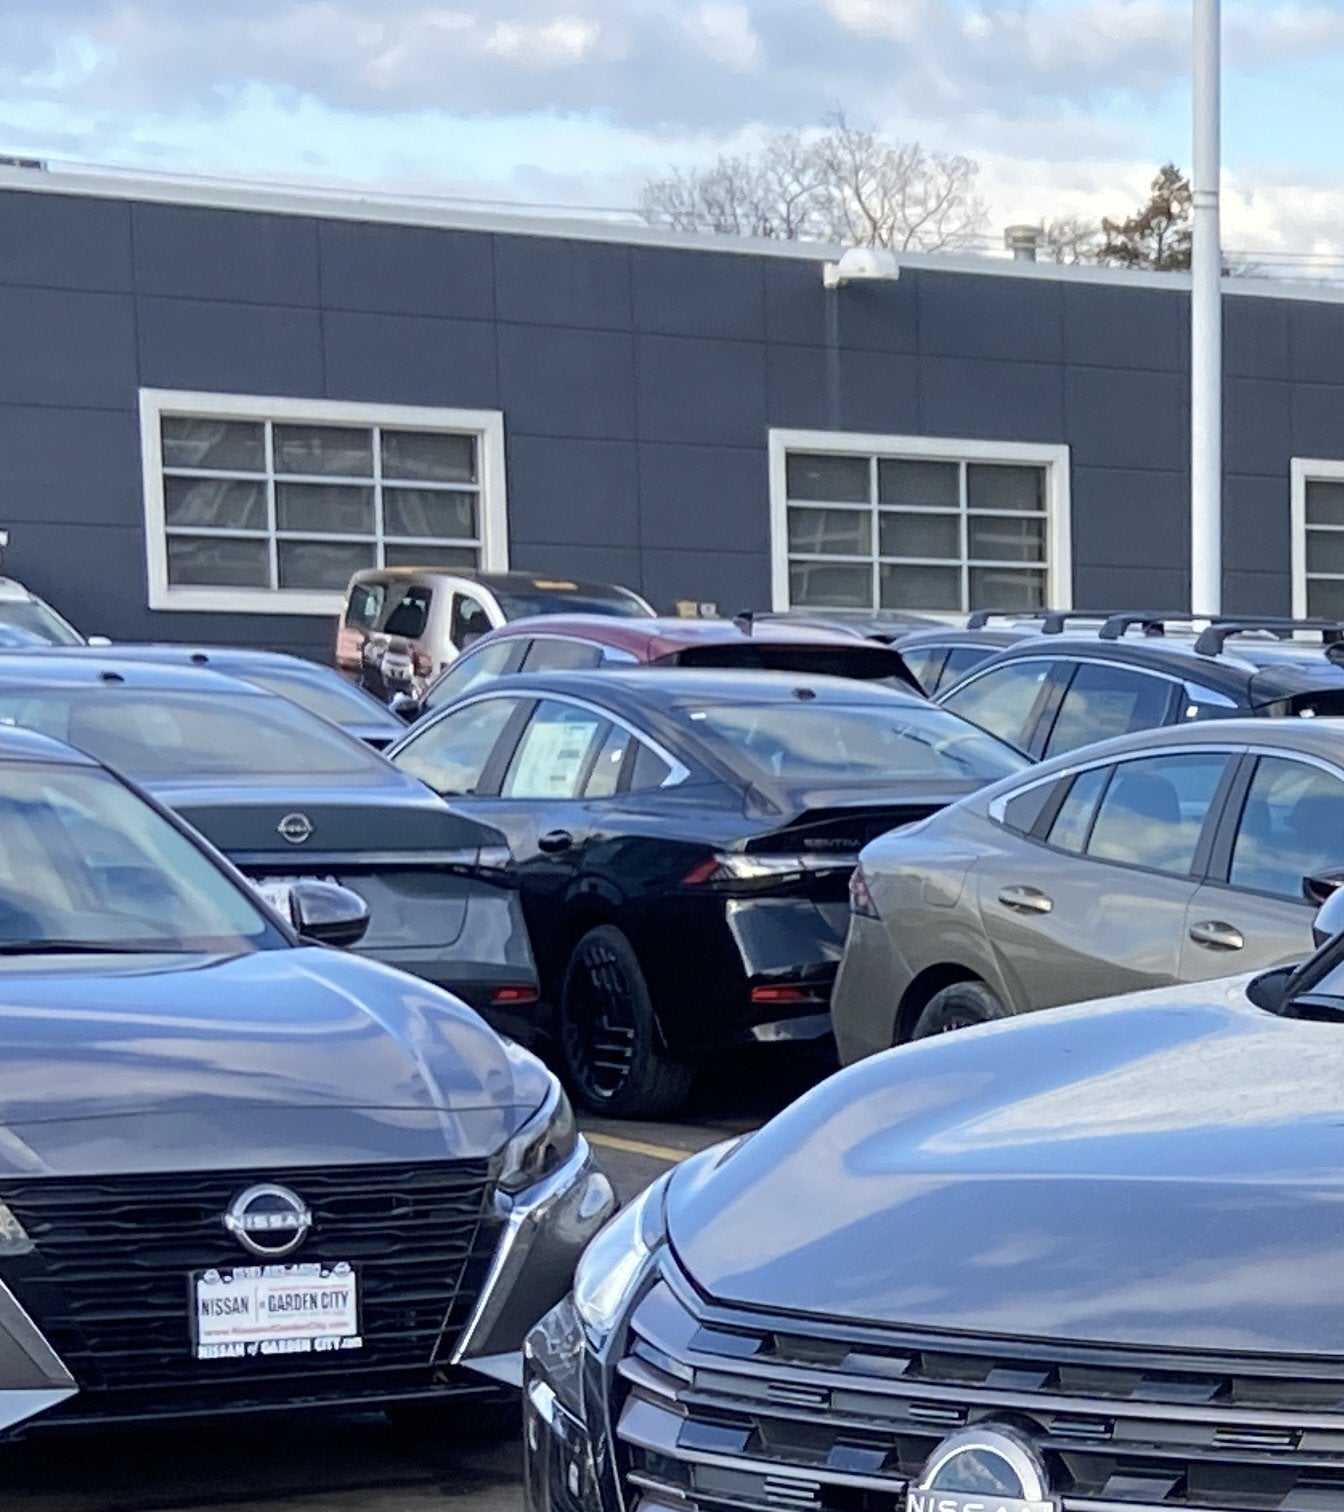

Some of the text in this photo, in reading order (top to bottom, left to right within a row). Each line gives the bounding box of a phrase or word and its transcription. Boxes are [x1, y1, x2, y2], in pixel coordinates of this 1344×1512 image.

[224, 1212, 312, 1231] NISSAN
[201, 1296, 249, 1316] NISSAN
[268, 1292, 318, 1313] GARDEN
[321, 1291, 349, 1309] CITY
